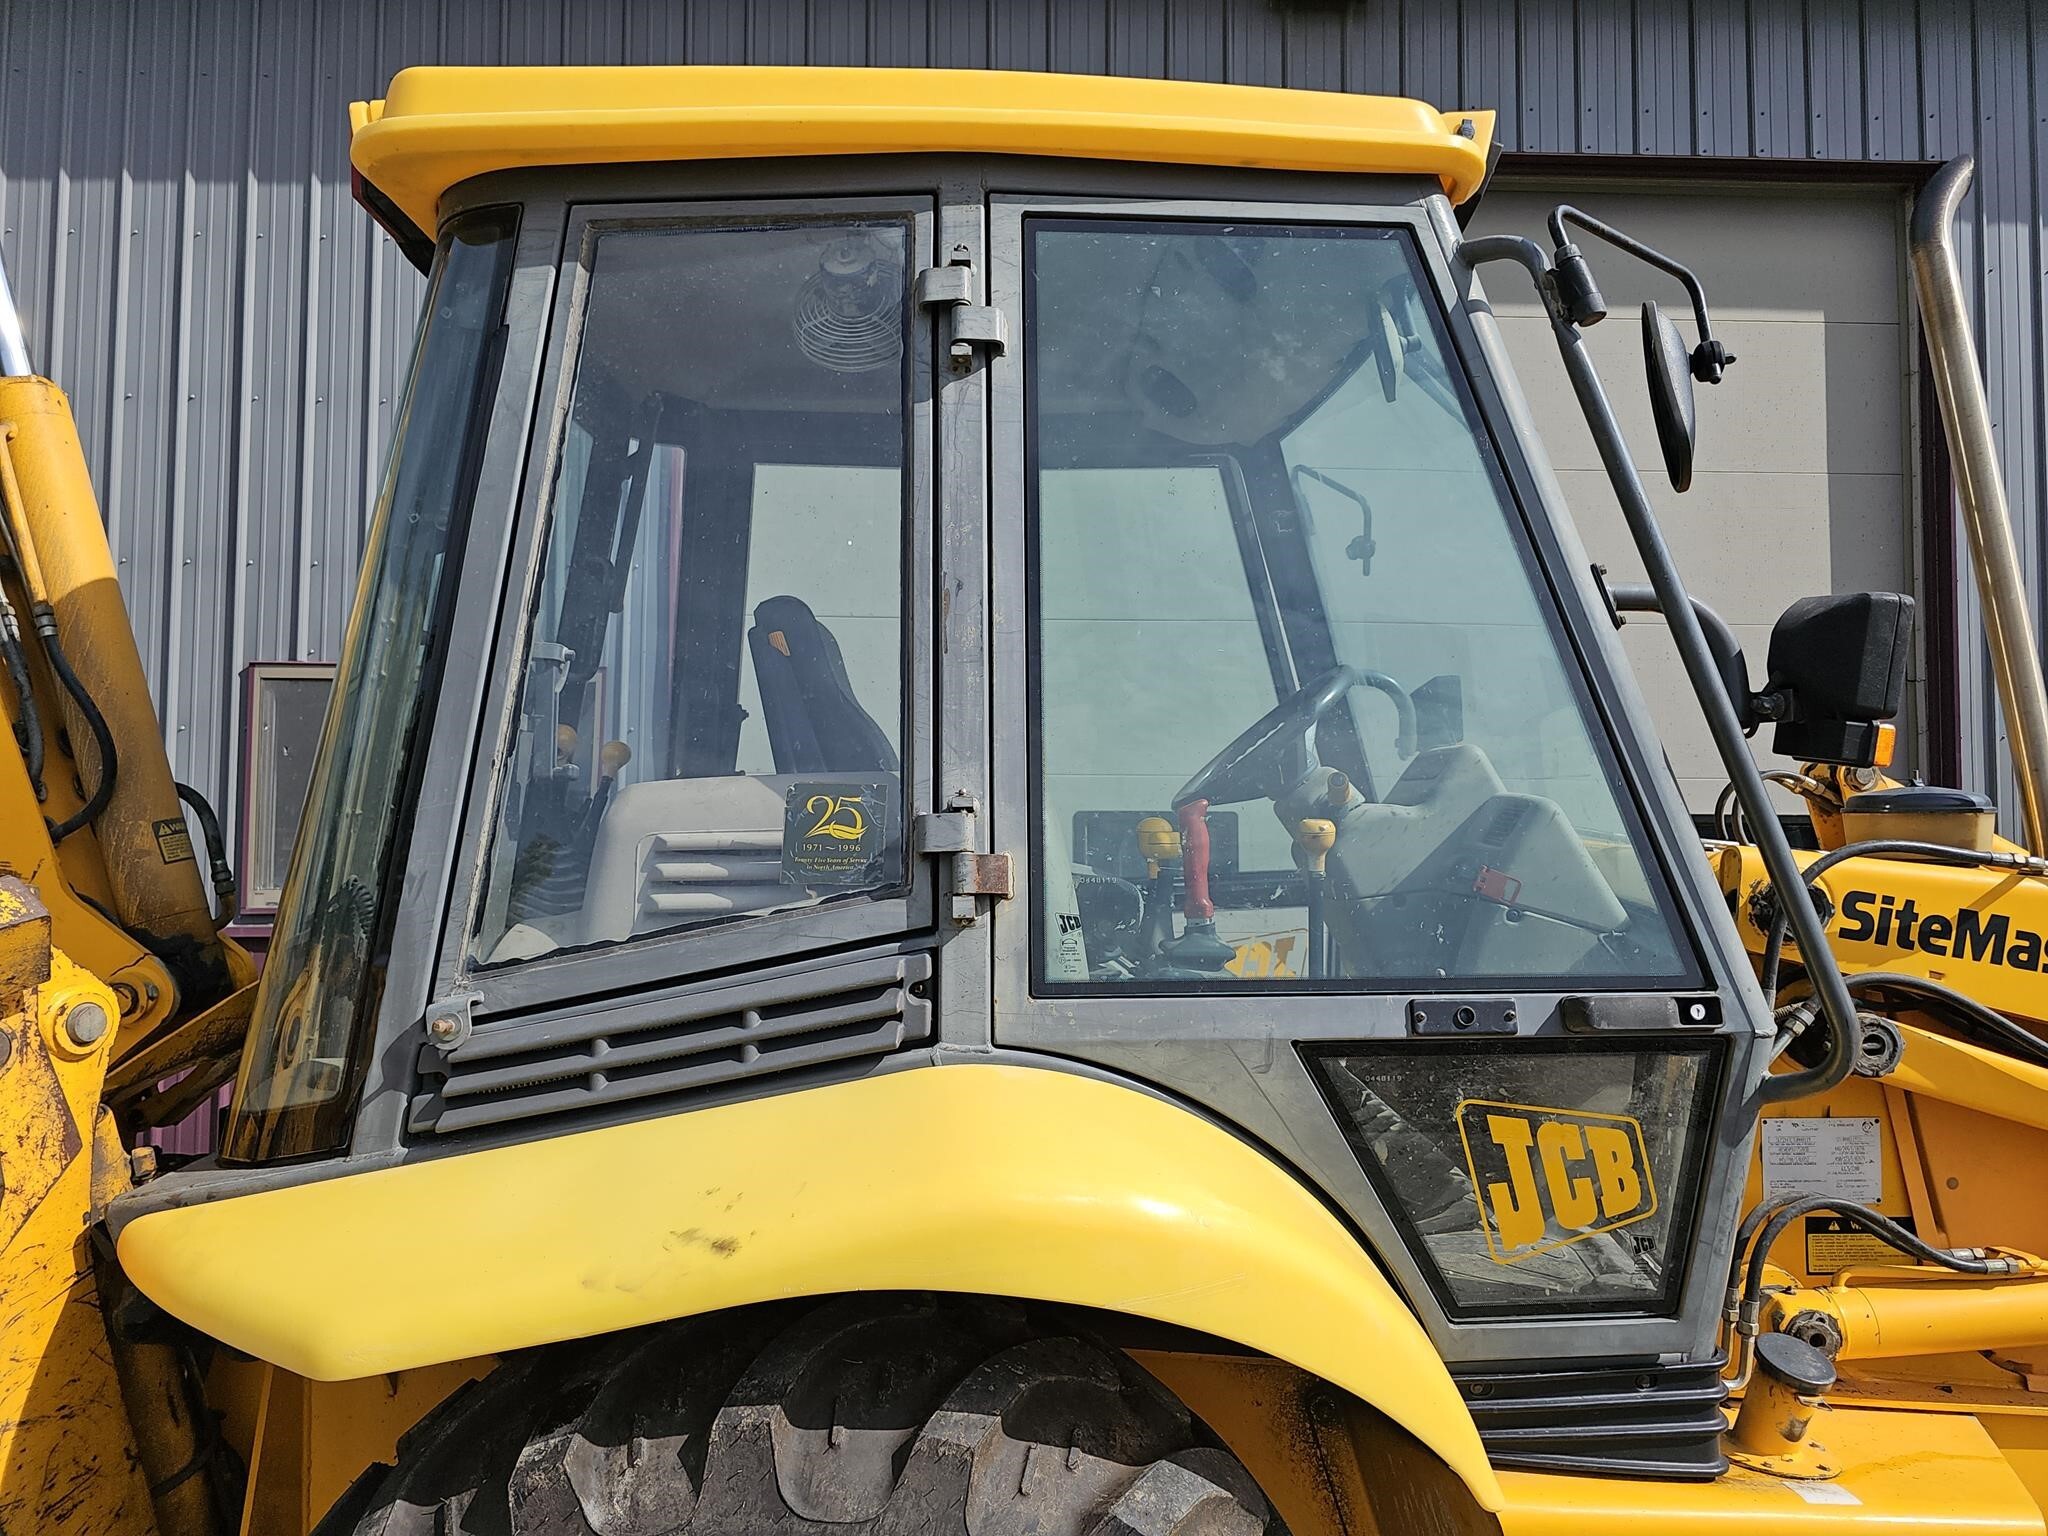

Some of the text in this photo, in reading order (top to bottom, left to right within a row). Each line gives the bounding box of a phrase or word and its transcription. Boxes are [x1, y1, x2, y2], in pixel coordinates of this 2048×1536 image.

[804, 795, 869, 840] 25
[802, 843, 822, 852] 1971
[838, 843, 861, 852] 1996
[1058, 914, 1082, 934] JCB
[1838, 890, 2048, 974] SiteMa
[1487, 1114, 1642, 1252] JCB
[1633, 1236, 1655, 1255] JCB
